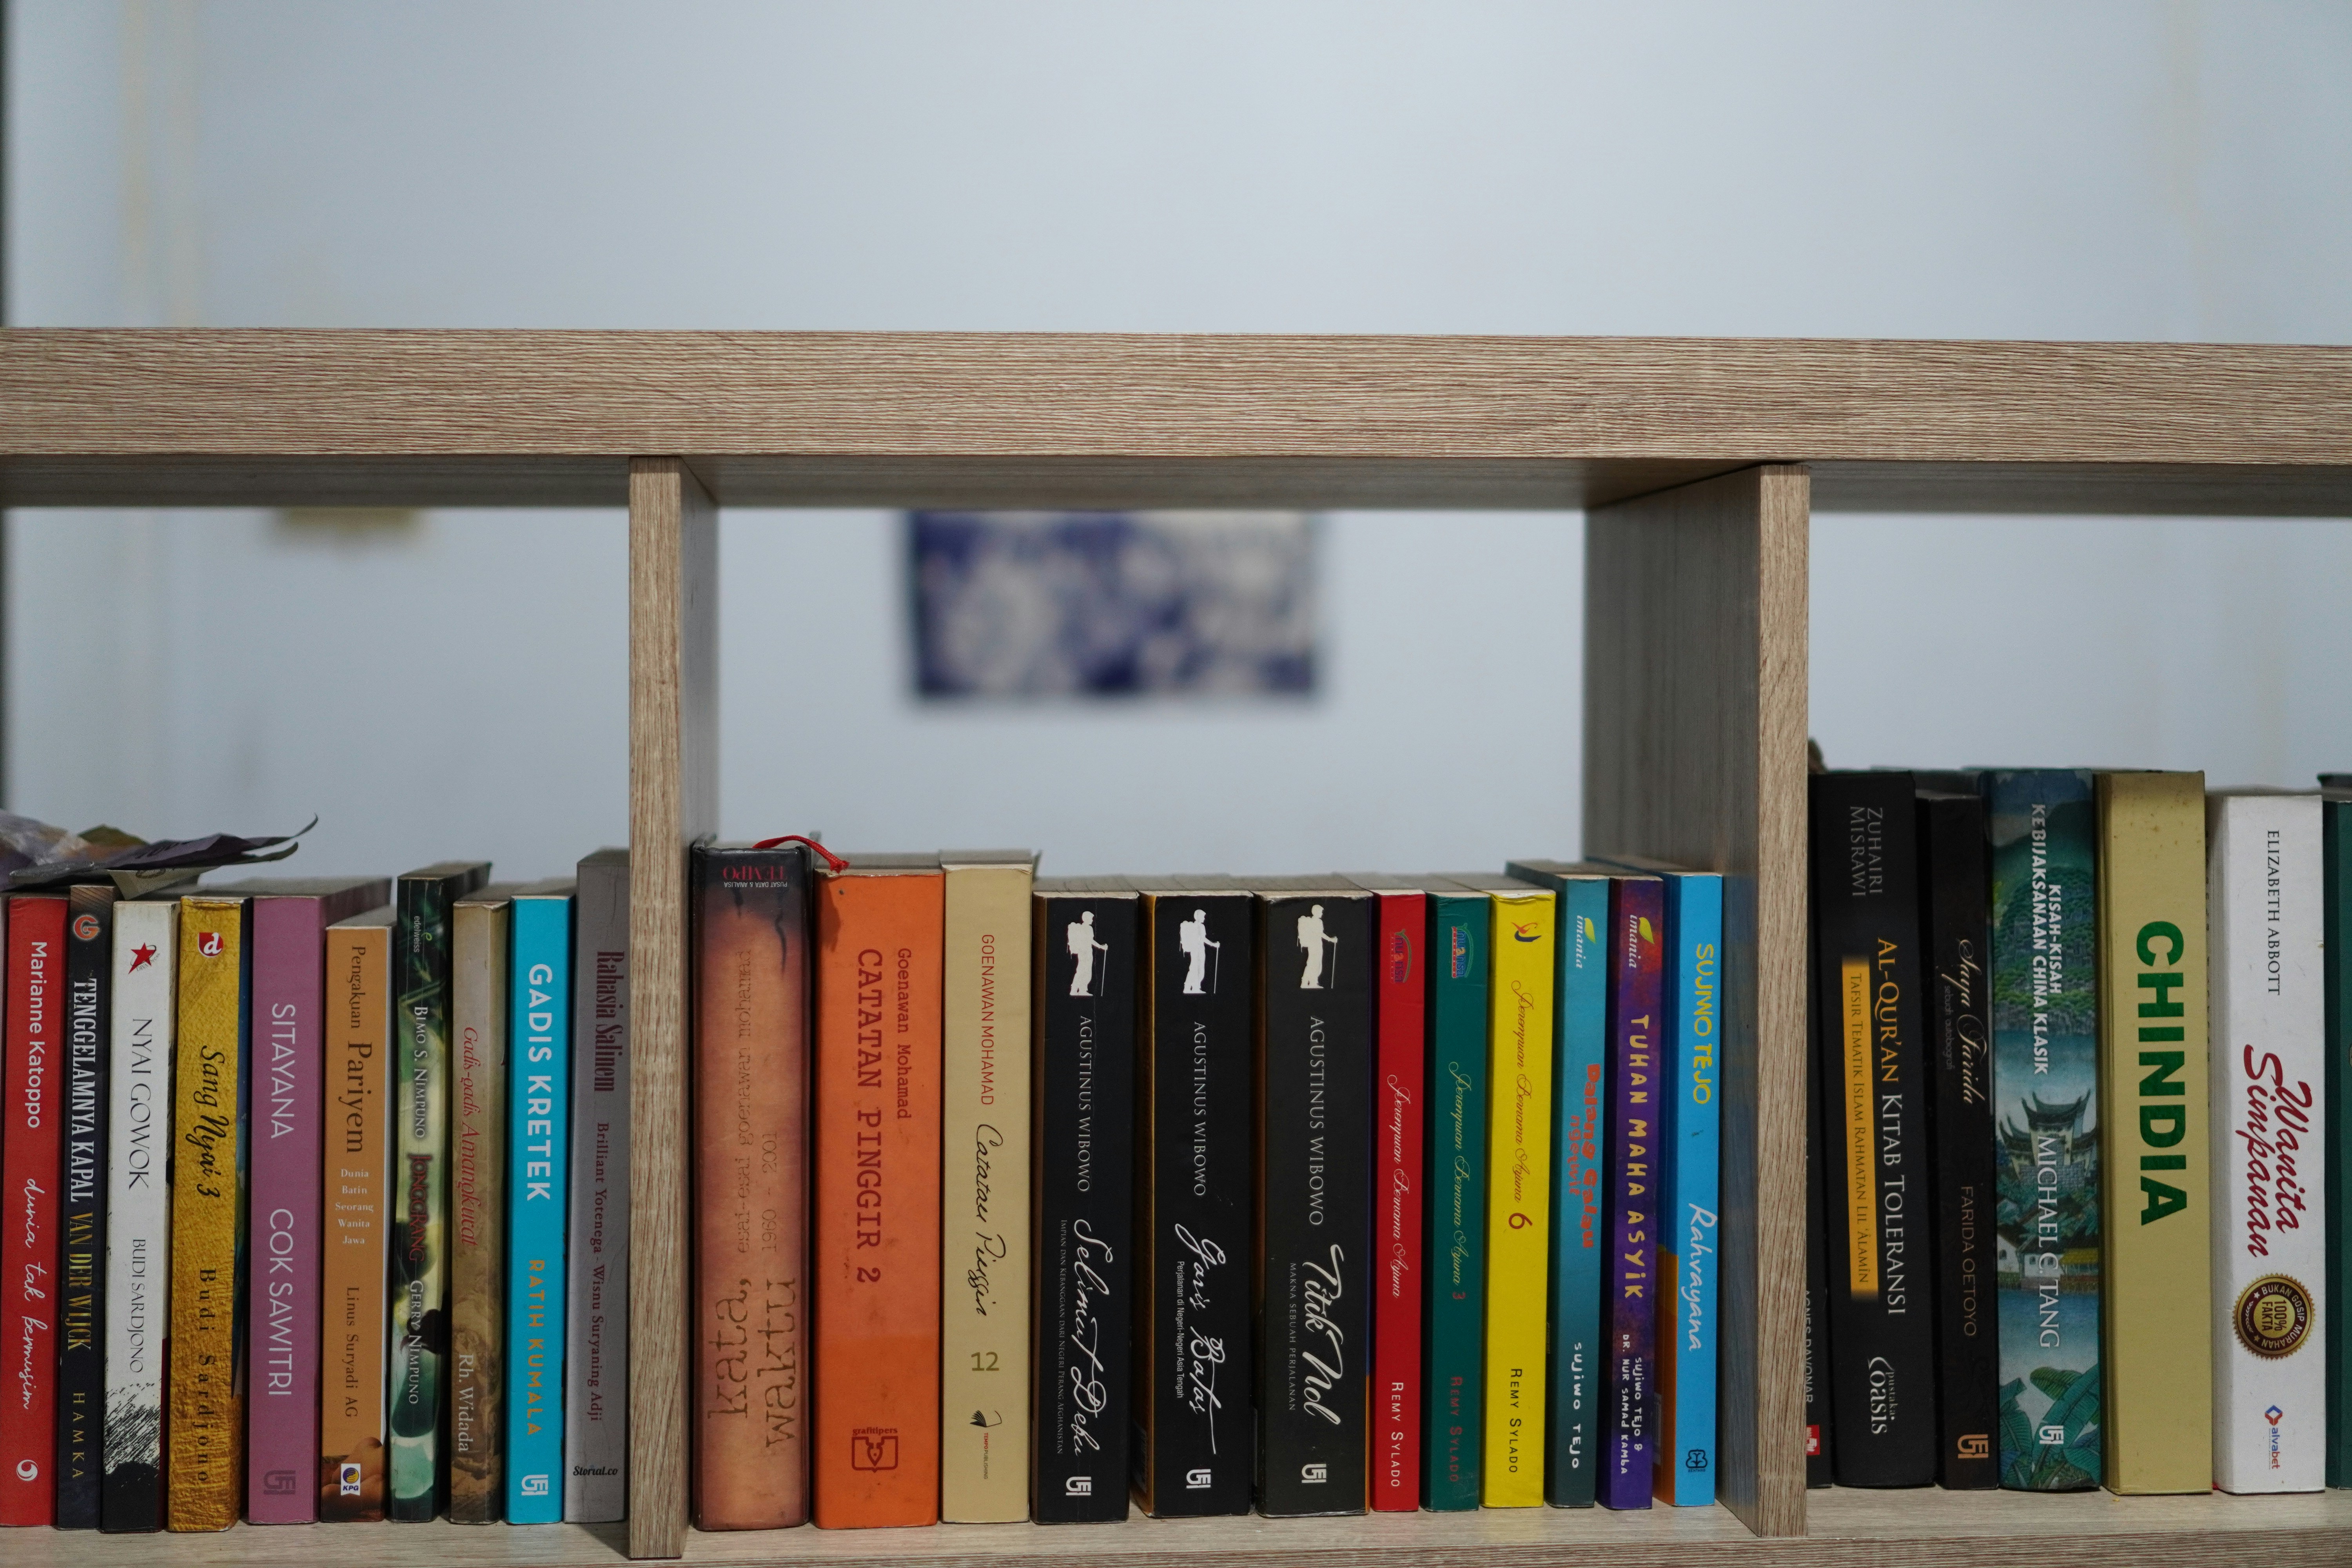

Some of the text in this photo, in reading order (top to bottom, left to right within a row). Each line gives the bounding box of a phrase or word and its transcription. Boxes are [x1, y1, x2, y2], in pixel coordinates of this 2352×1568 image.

[1849, 805, 1866, 897] MISRAWI
[1867, 807, 1883, 895] ZUHAIRI
[2268, 829, 2280, 996] ELIZABETH ABBOTT
[413, 915, 421, 953] edelweiss
[1575, 915, 1586, 969] imania
[1628, 915, 1641, 969] imania
[1944, 985, 1954, 1015] sebuah
[2031, 804, 2049, 1076] KEBIJAKSANAAN CHINA KLASIK
[2049, 884, 2062, 995] KISAH-KISAH
[25, 941, 47, 1128] Marianne Katoppo
[271, 1003, 296, 1139] SITAYANA
[338, 946, 372, 1154] Pengakuan Pariyem
[414, 1006, 428, 1138] BIMO NIMPUNO
[527, 963, 553, 1201] GADIS KRETEK
[594, 951, 624, 1092] Rahasia Salinem
[897, 948, 912, 1119] Goenawan Mohamad
[980, 934, 995, 1105] GOENAWAN MOHAMAD
[1693, 943, 1715, 1104] SUJIWO TEJO
[1850, 973, 1869, 1200] TAFSIR TEMATIK ISLAM RAHMATAN
[2136, 920, 2187, 1226] CHINDIA
[65, 978, 97, 1352] TENGGELAMNYA KAPAL VAN DER WIJCK
[129, 1018, 152, 1191] NYAI GOWOK
[185, 1045, 229, 1198] Sang Nyai 3
[340, 1169, 369, 1177] Dunia
[457, 1027, 481, 1247] Gadis-gadis Amangkurat
[735, 949, 753, 1253] esai-esai goenawan mohamad
[857, 948, 882, 1283] CATATAN PINGGIR 2
[1078, 1015, 1092, 1192] AGUSTINUS WIBOWO
[1194, 1021, 1207, 1196] AGUSTINUS WIBOWO
[1308, 1016, 1325, 1225] AGUSTINUS WIBOWO
[1508, 980, 1534, 1229] Perempuan Bernama Arjuna 6
[1567, 1115, 1581, 1196] ngetwit
[1581, 1063, 1601, 1248] Dalang Galau
[1627, 1014, 1650, 1196] TUHAN MAHA
[2274, 1080, 2312, 1234] Wanita
[335, 1202, 374, 1213] Seorang
[338, 1218, 370, 1228] Wanita
[342, 1185, 367, 1194] Batin
[342, 1236, 365, 1244] Jawa
[762, 1209, 778, 1252] 1960
[968, 1123, 1006, 1316] Catatan Pinggir
[1387, 1074, 1411, 1299] Perempuan Bernama Arjuna
[1448, 1061, 1472, 1300] Perempuan Bernama Arjuna 3
[1881, 1094, 1907, 1316] KITAB TOLERANSI
[2038, 1136, 2060, 1349] MICHAEL C. TANG
[19, 1178, 48, 1410] dunia tak bermusim
[127, 1238, 146, 1373] BUDI SARDJONO
[268, 1208, 294, 1395] COK SAWITRI
[588, 1122, 609, 1421] Brilliant Yotenega Wisnu Suryaning Adji
[1059, 1268, 1067, 1318] KEBANGGAAN
[1071, 1219, 1113, 1372] Selimut
[1175, 1307, 1185, 1356] Negeri-Negeri
[1176, 1260, 1185, 1297] Perjalanan
[1681, 1203, 1718, 1352] Rahvayana
[1960, 1186, 1977, 1337] FARIDA OETOYO
[2261, 1301, 2273, 1331] FAKTA
[2274, 1299, 2287, 1331] 100%
[192, 1268, 216, 1483] Budi Sardjono
[342, 1287, 359, 1418] Linus Suryadi AG
[408, 1279, 424, 1404] GERRY NIMPUNO
[458, 1354, 474, 1452] Rh. Widada
[527, 1259, 546, 1436] RATIH KUMALA
[707, 1278, 751, 1419] kata,
[757, 1278, 796, 1448] waktu
[971, 1352, 999, 1371] 12
[1175, 1373, 1184, 1399] Tengah
[1288, 1348, 1296, 1410] PERJALANAN
[1621, 1334, 1630, 1381] DR. NUR
[1886, 1372, 1896, 1414] pustaka
[573, 1466, 618, 1476] Storial.co
[1390, 1381, 1404, 1488] REMY SYLADO
[1450, 1376, 1463, 1483] REMY SYLADO
[1508, 1368, 1523, 1473] REMY SYLADO
[2272, 1427, 2280, 1470] alvabet
